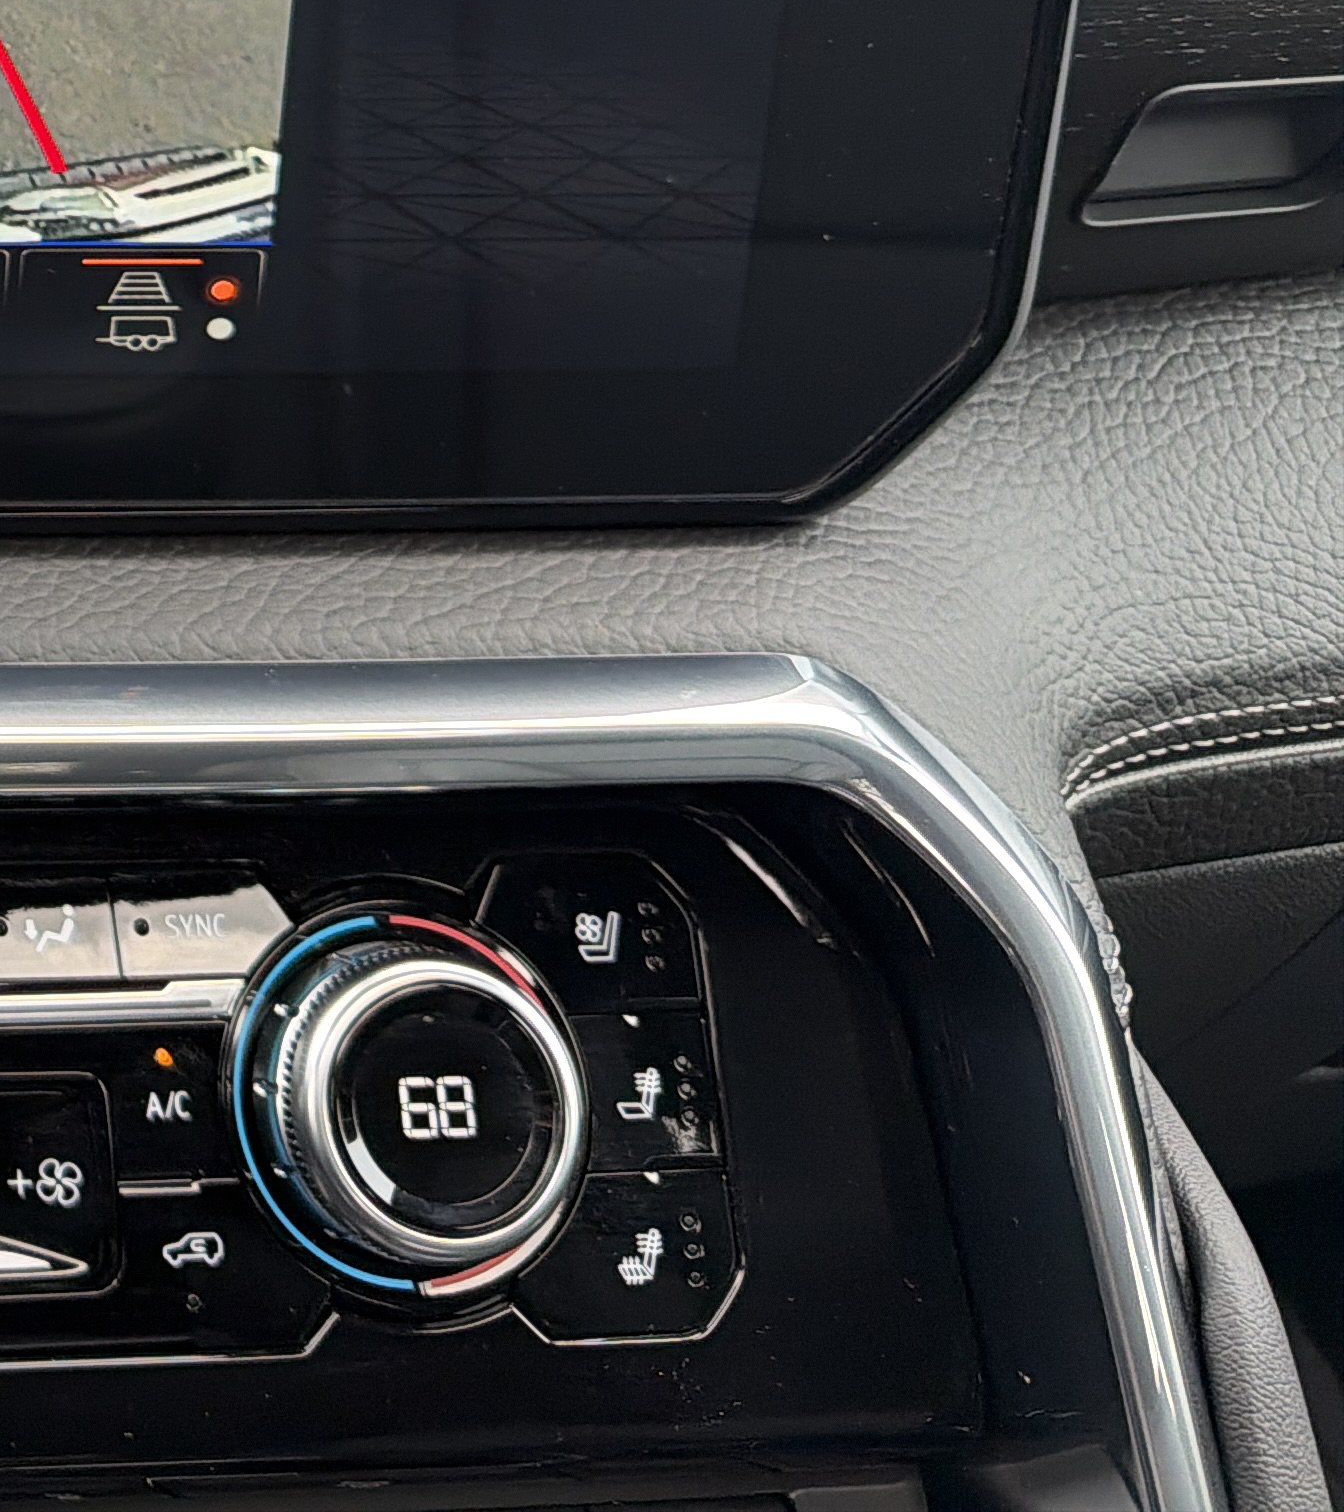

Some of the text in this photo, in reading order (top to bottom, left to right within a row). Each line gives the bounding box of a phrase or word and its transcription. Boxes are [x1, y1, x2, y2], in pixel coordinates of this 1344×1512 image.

[163, 913, 228, 940] SYNC
[145, 1091, 193, 1121] A/C
[398, 1076, 477, 1139] 68
